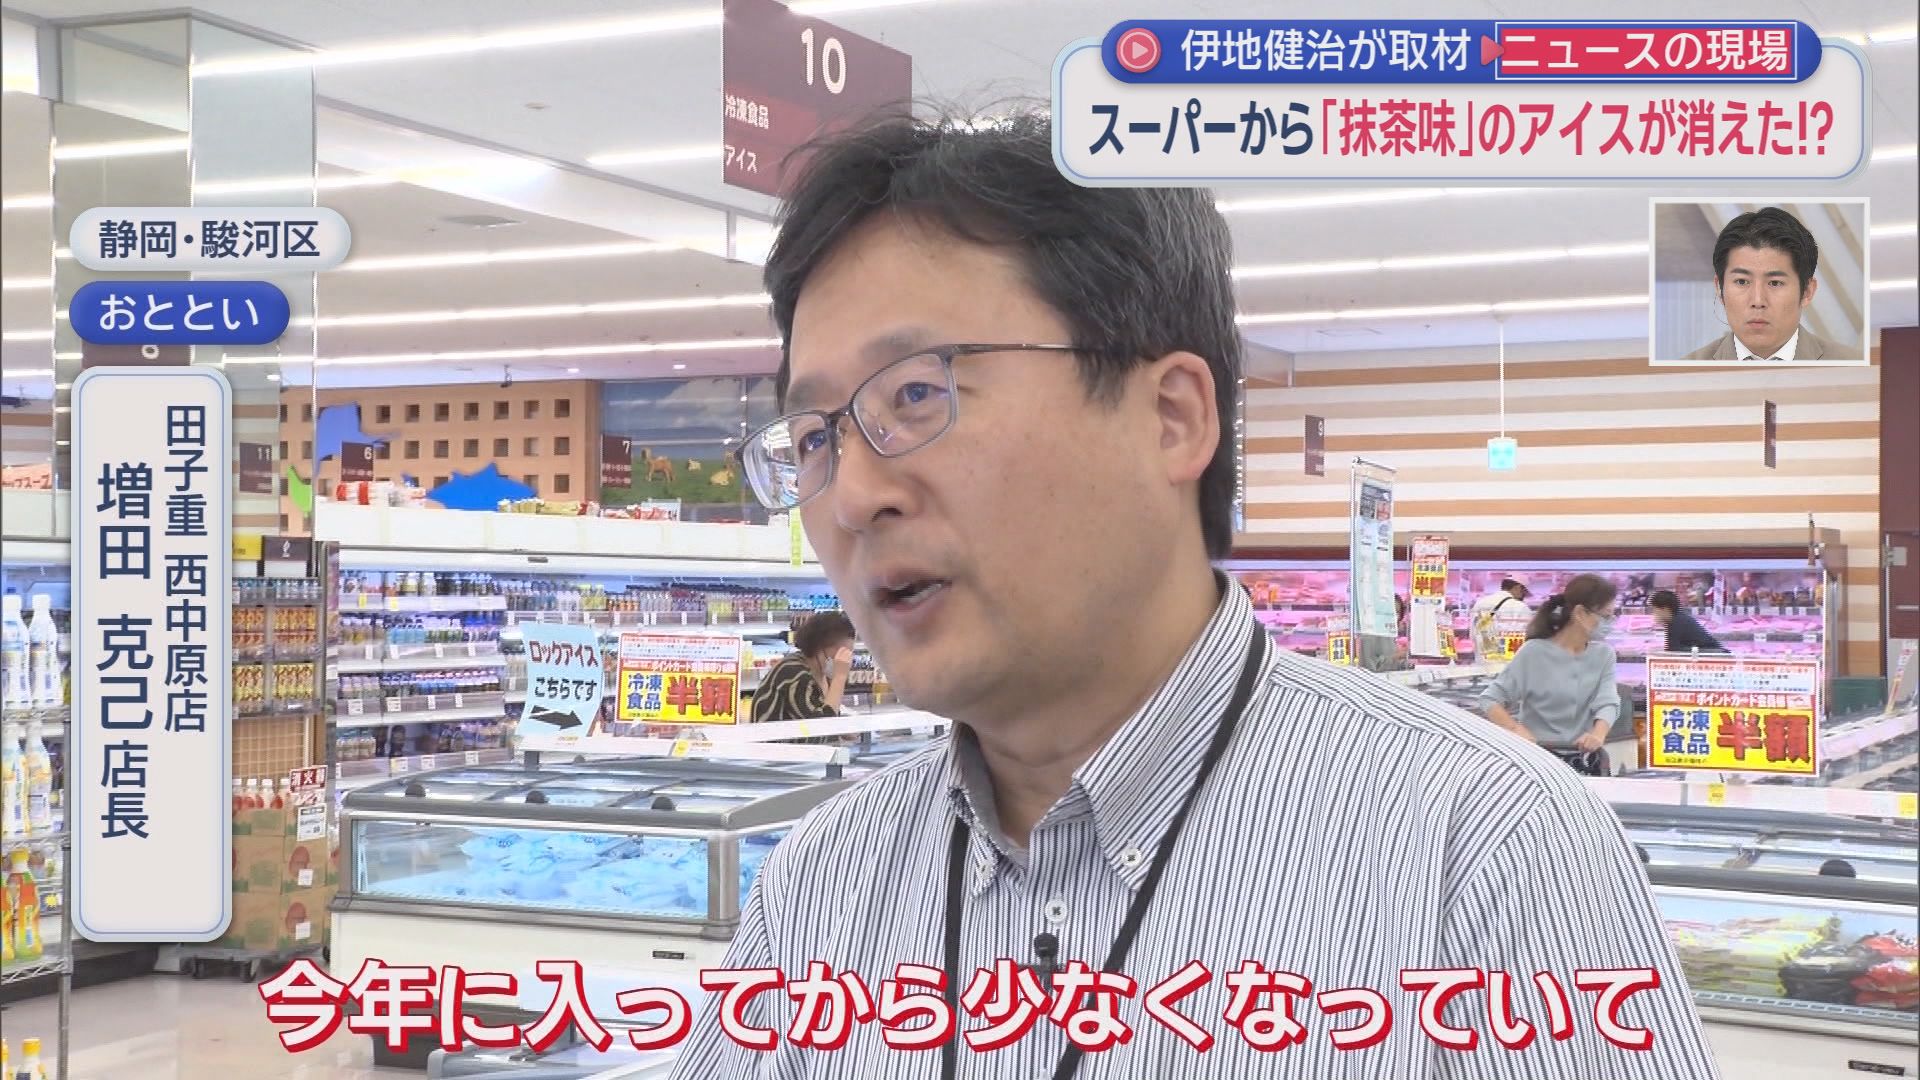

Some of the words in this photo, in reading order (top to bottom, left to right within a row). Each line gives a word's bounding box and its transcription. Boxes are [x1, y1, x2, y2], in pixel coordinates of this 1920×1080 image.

[800, 27, 847, 95] 10
[725, 95, 769, 130] 冷凍食品
[725, 144, 758, 173] アイス
[257, 446, 271, 462] 11
[363, 446, 372, 460] 6
[621, 440, 632, 455] 7
[528, 639, 600, 669] ロックアイス
[534, 676, 599, 702] こちらです
[627, 673, 663, 690] 冷凍
[666, 675, 734, 718] 半額
[627, 691, 662, 711] 食品
[1661, 707, 1711, 731] 冷凍
[1716, 710, 1810, 764] 半額
[1661, 732, 1711, 756] 食品
